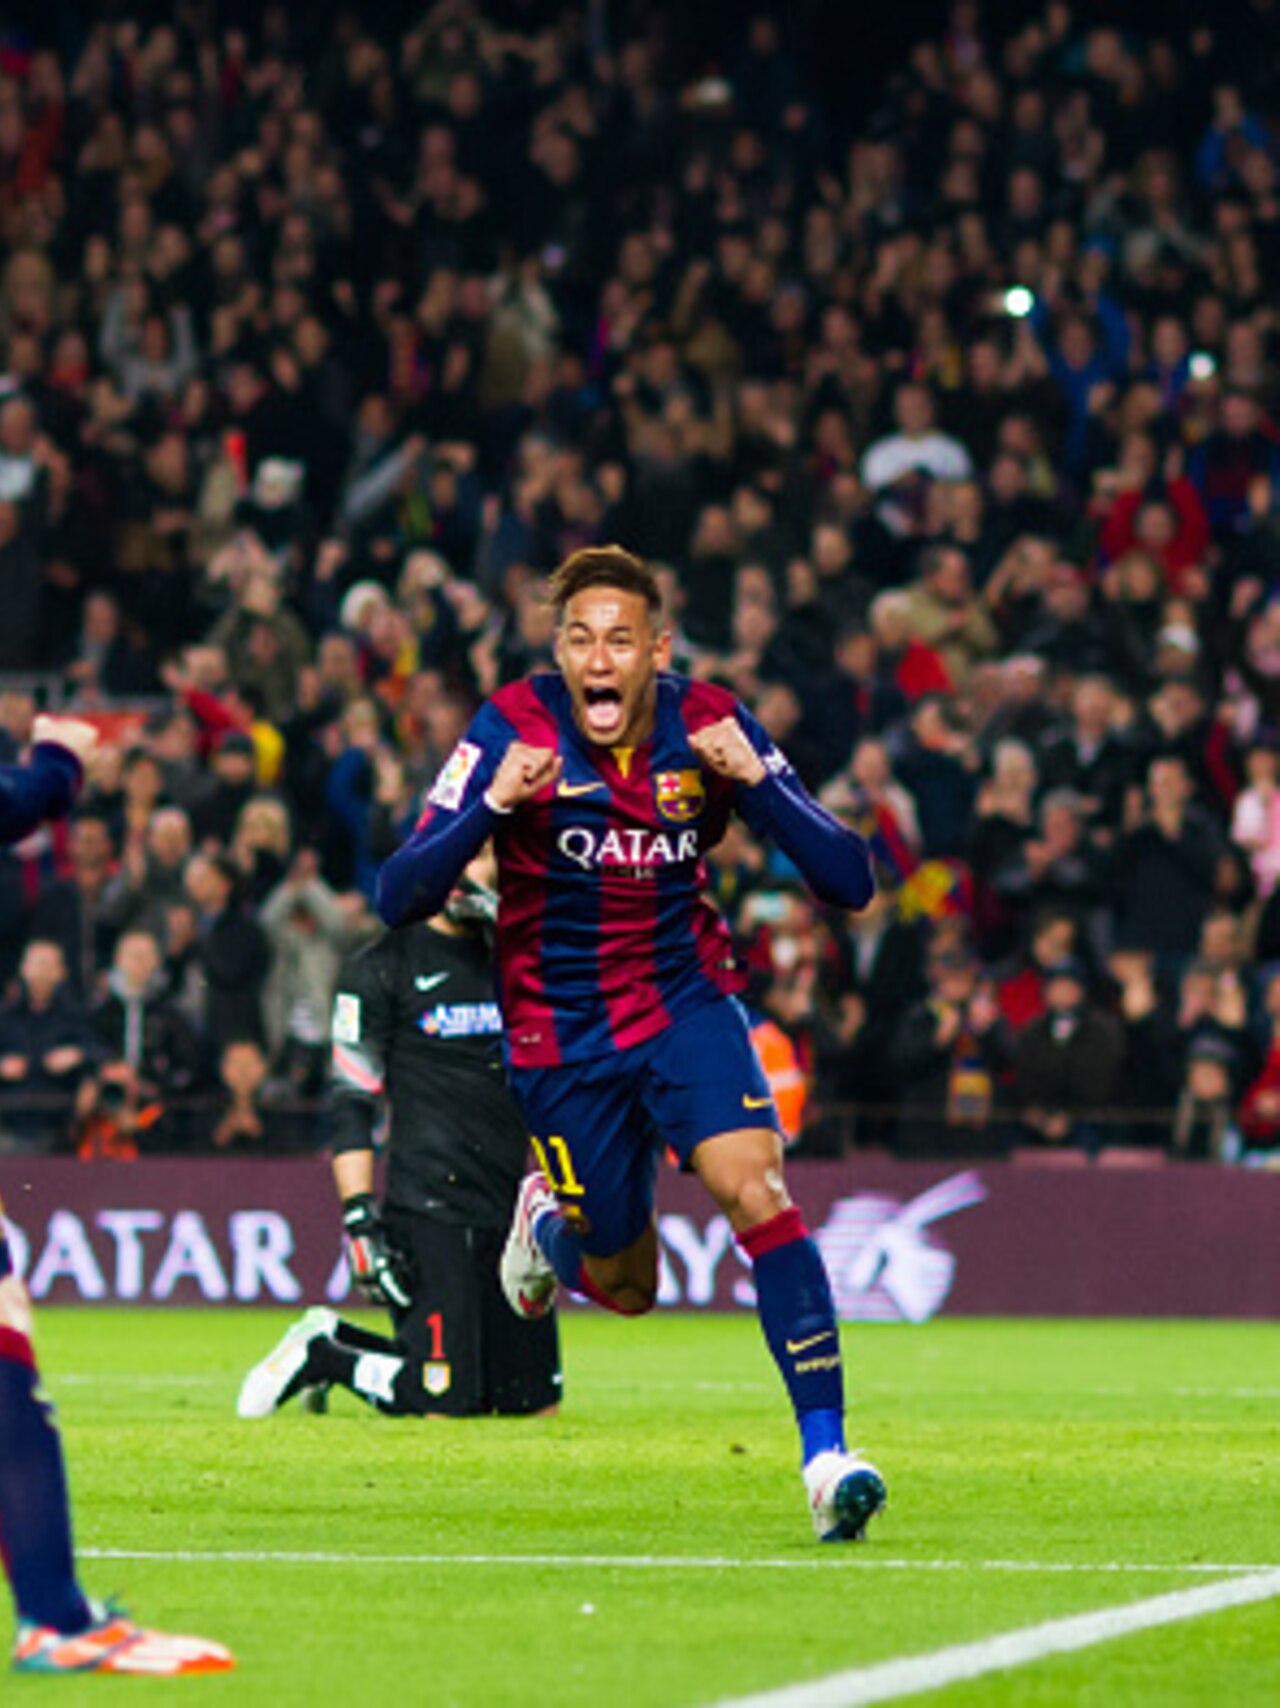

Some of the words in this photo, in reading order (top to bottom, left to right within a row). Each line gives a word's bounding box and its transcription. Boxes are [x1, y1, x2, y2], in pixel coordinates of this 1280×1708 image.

[556, 828, 699, 870] QATAR
[529, 1135, 587, 1197] 11
[4, 1208, 302, 1300] ATAR
[424, 1311, 447, 1360] 1
